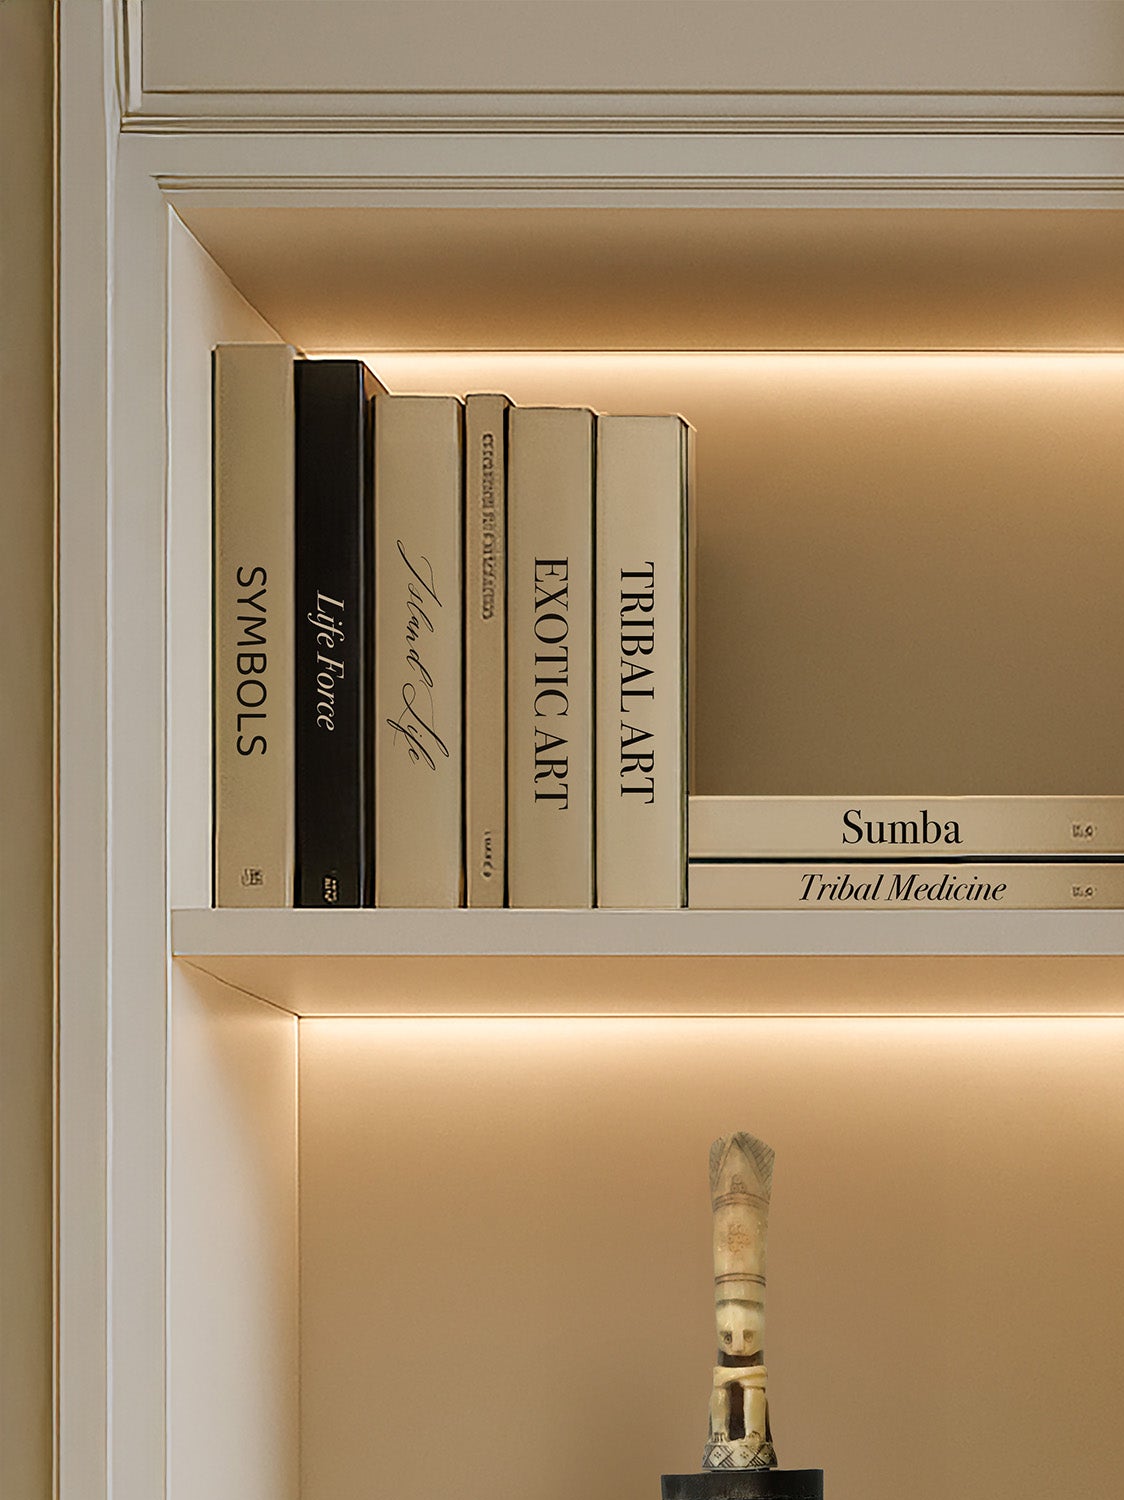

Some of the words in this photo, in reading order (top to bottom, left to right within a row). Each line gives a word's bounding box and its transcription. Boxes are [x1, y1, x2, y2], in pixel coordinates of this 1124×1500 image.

[307, 589, 345, 649] Life
[396, 539, 443, 688] Island
[533, 557, 569, 717] EXOTIC
[620, 561, 655, 712] TRIBAL
[236, 567, 268, 756] SYMBOLS
[316, 650, 345, 731] Force
[386, 681, 450, 771] Life
[533, 724, 569, 810] ART
[620, 720, 655, 804] ART
[842, 809, 964, 845] Sumba
[799, 873, 884, 901] Tribal
[885, 873, 1007, 901] Medicine
